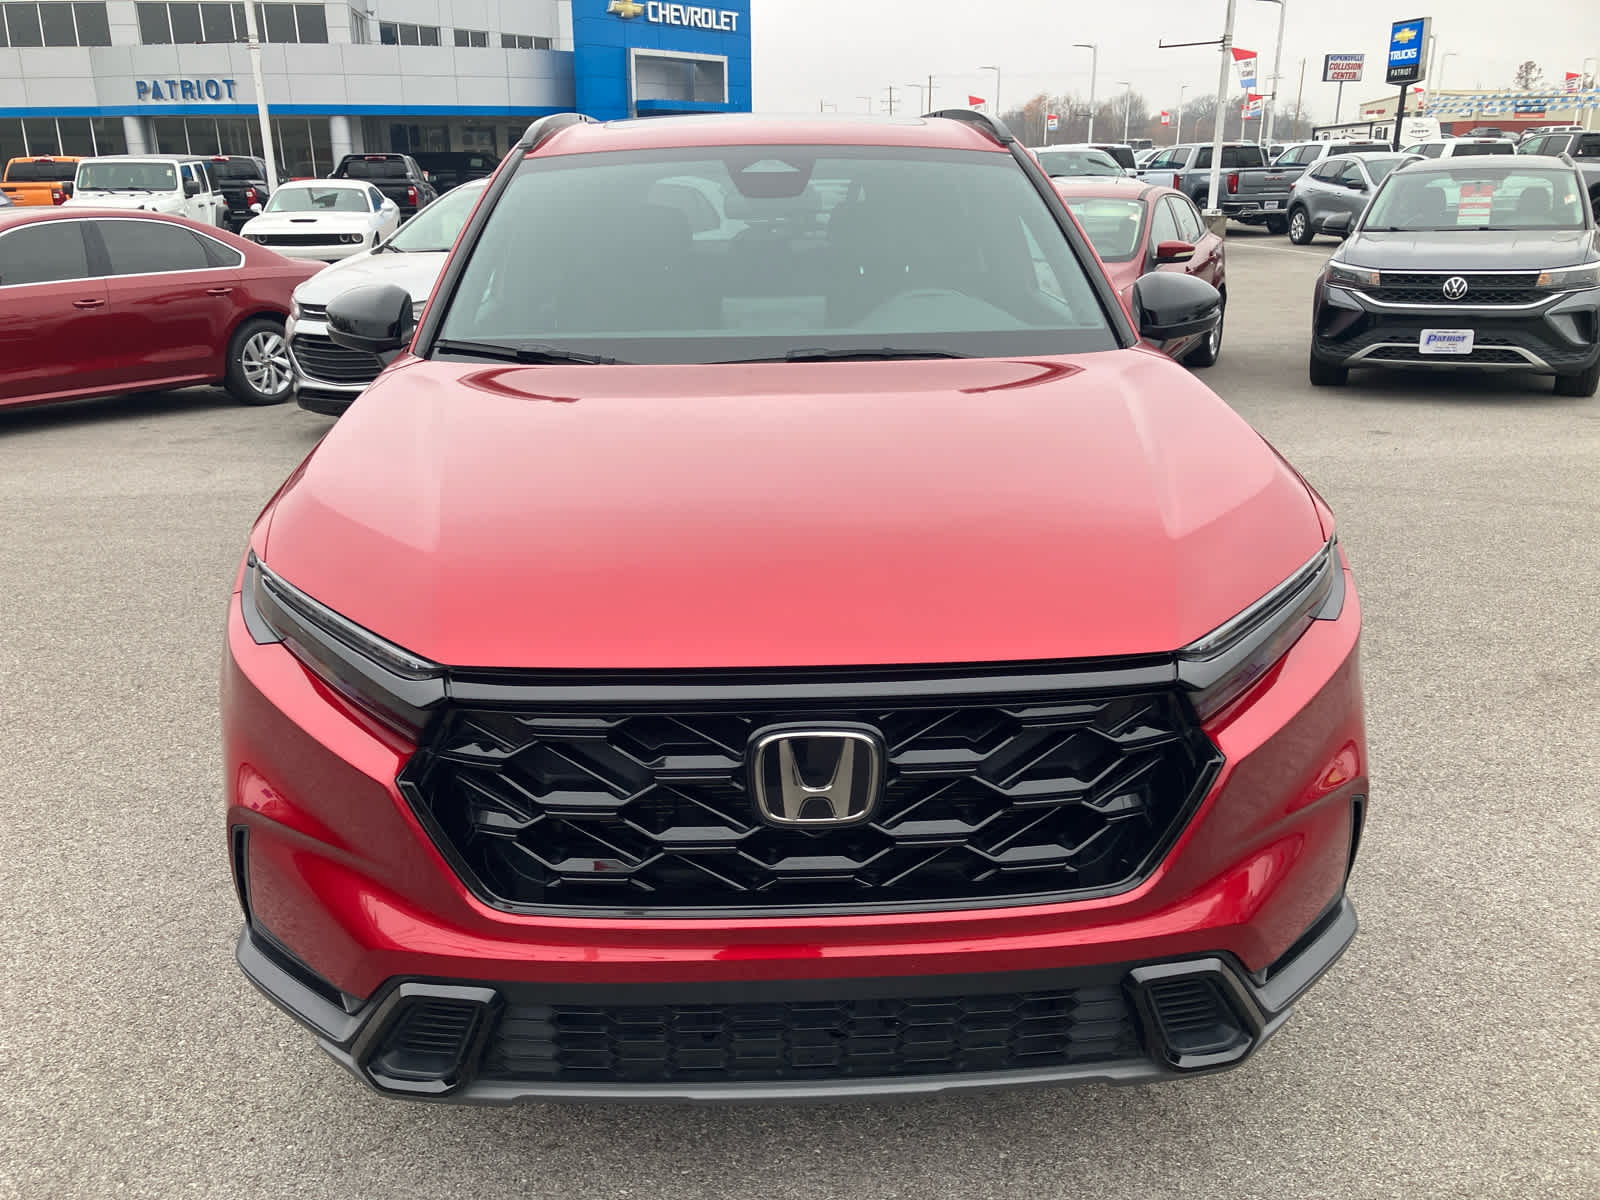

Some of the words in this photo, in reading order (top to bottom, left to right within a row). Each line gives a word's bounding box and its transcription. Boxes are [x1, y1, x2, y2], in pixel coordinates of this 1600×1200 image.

[647, 1, 739, 32] CHEVROLET
[1390, 48, 1417, 61] TRUCKS
[1329, 62, 1363, 71] COLLISION
[1391, 68, 1412, 76] PATRIOT
[1331, 71, 1357, 80] CENTER
[136, 79, 236, 100] PATRIOT
